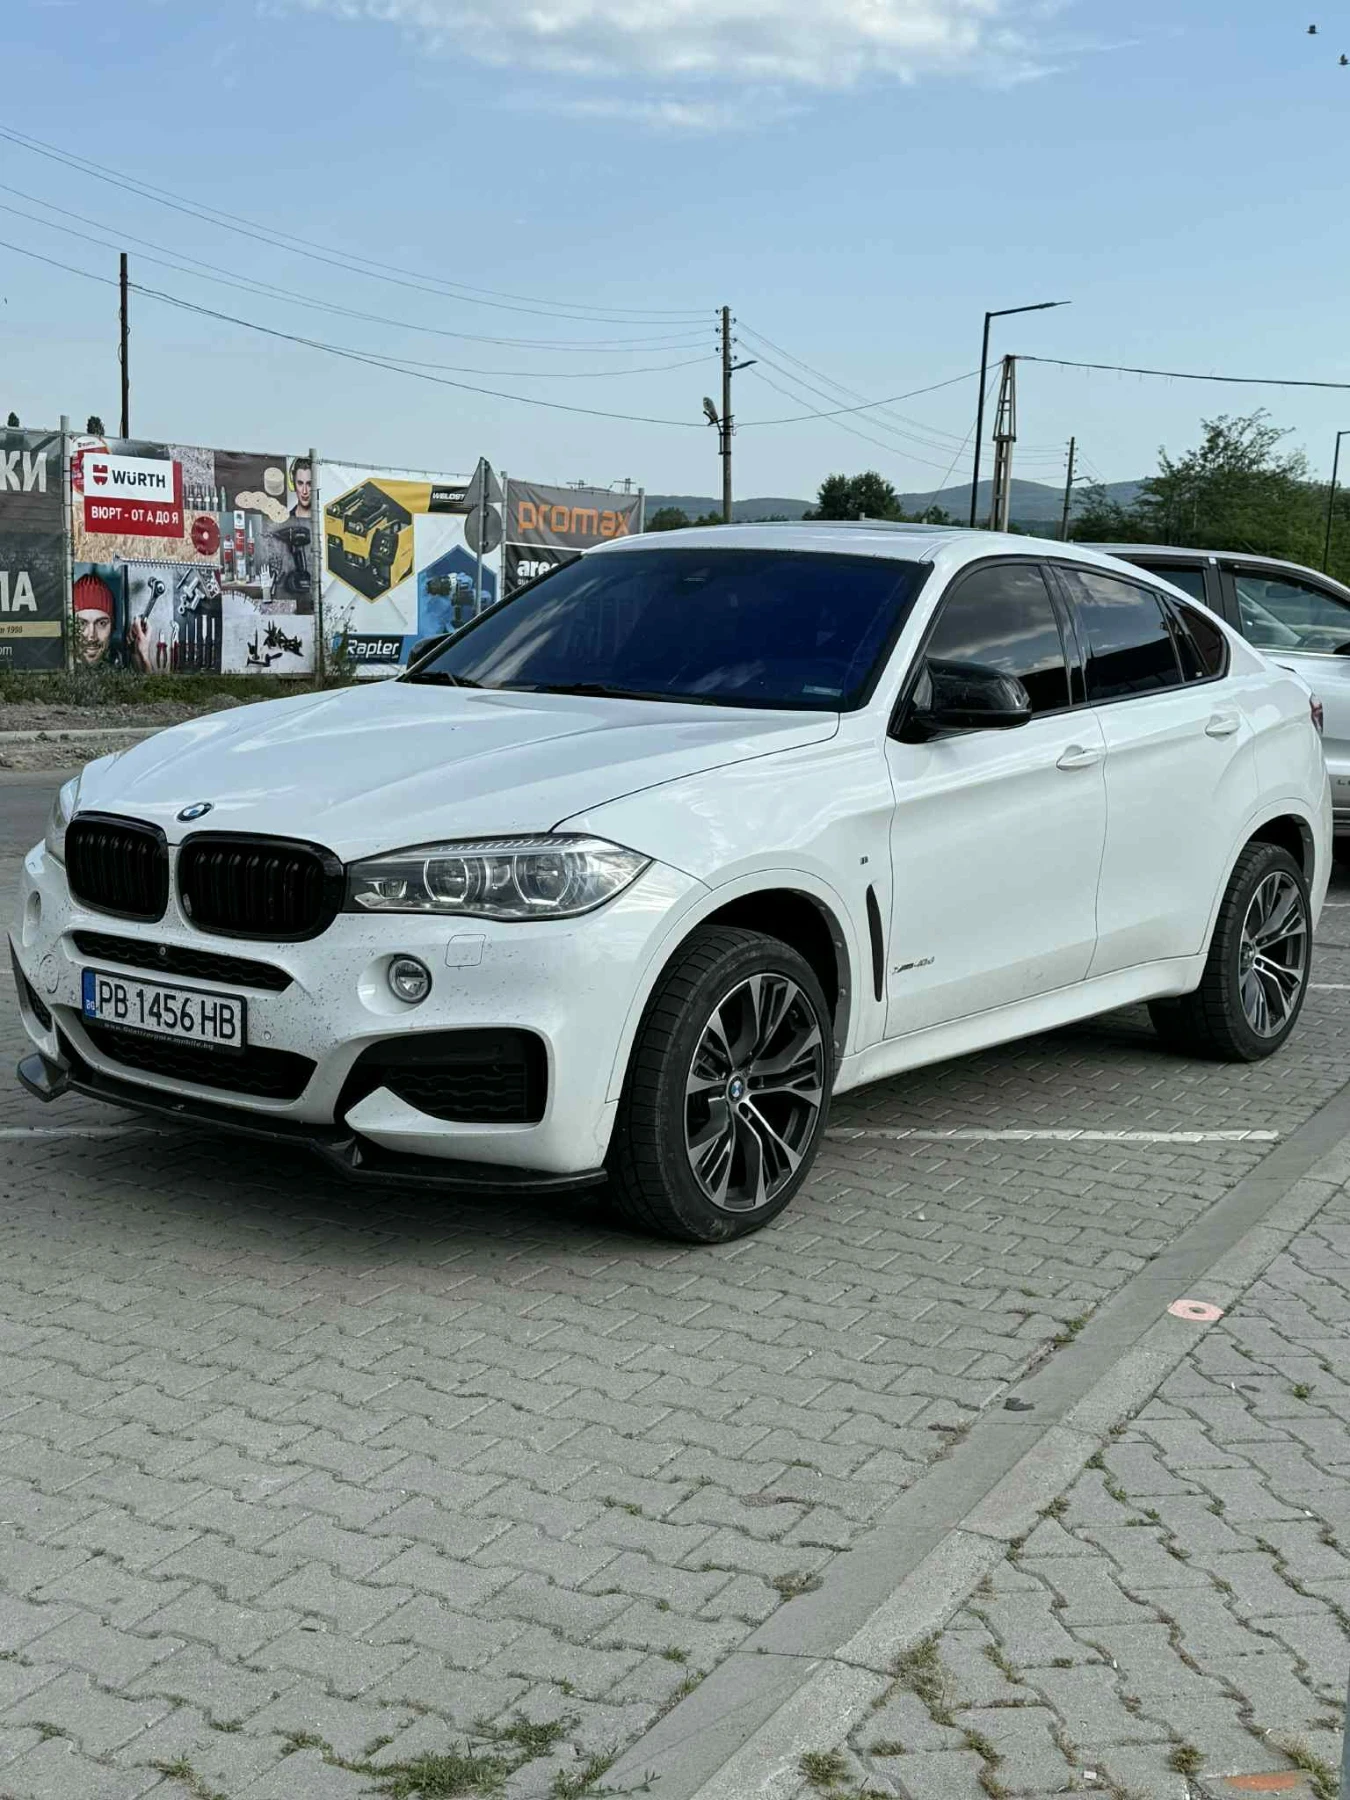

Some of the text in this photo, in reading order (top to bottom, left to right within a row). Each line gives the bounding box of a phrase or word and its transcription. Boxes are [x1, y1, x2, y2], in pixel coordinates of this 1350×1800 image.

[91, 506, 122, 520] ВЮРТ
[131, 509, 145, 522] ОТ
[147, 510, 154, 523] А
[155, 510, 170, 525] ДО
[172, 512, 179, 524] Я
[518, 501, 630, 537] promax
[346, 639, 399, 658] Rapter
[100, 980, 236, 1039] PB 1456 HB
